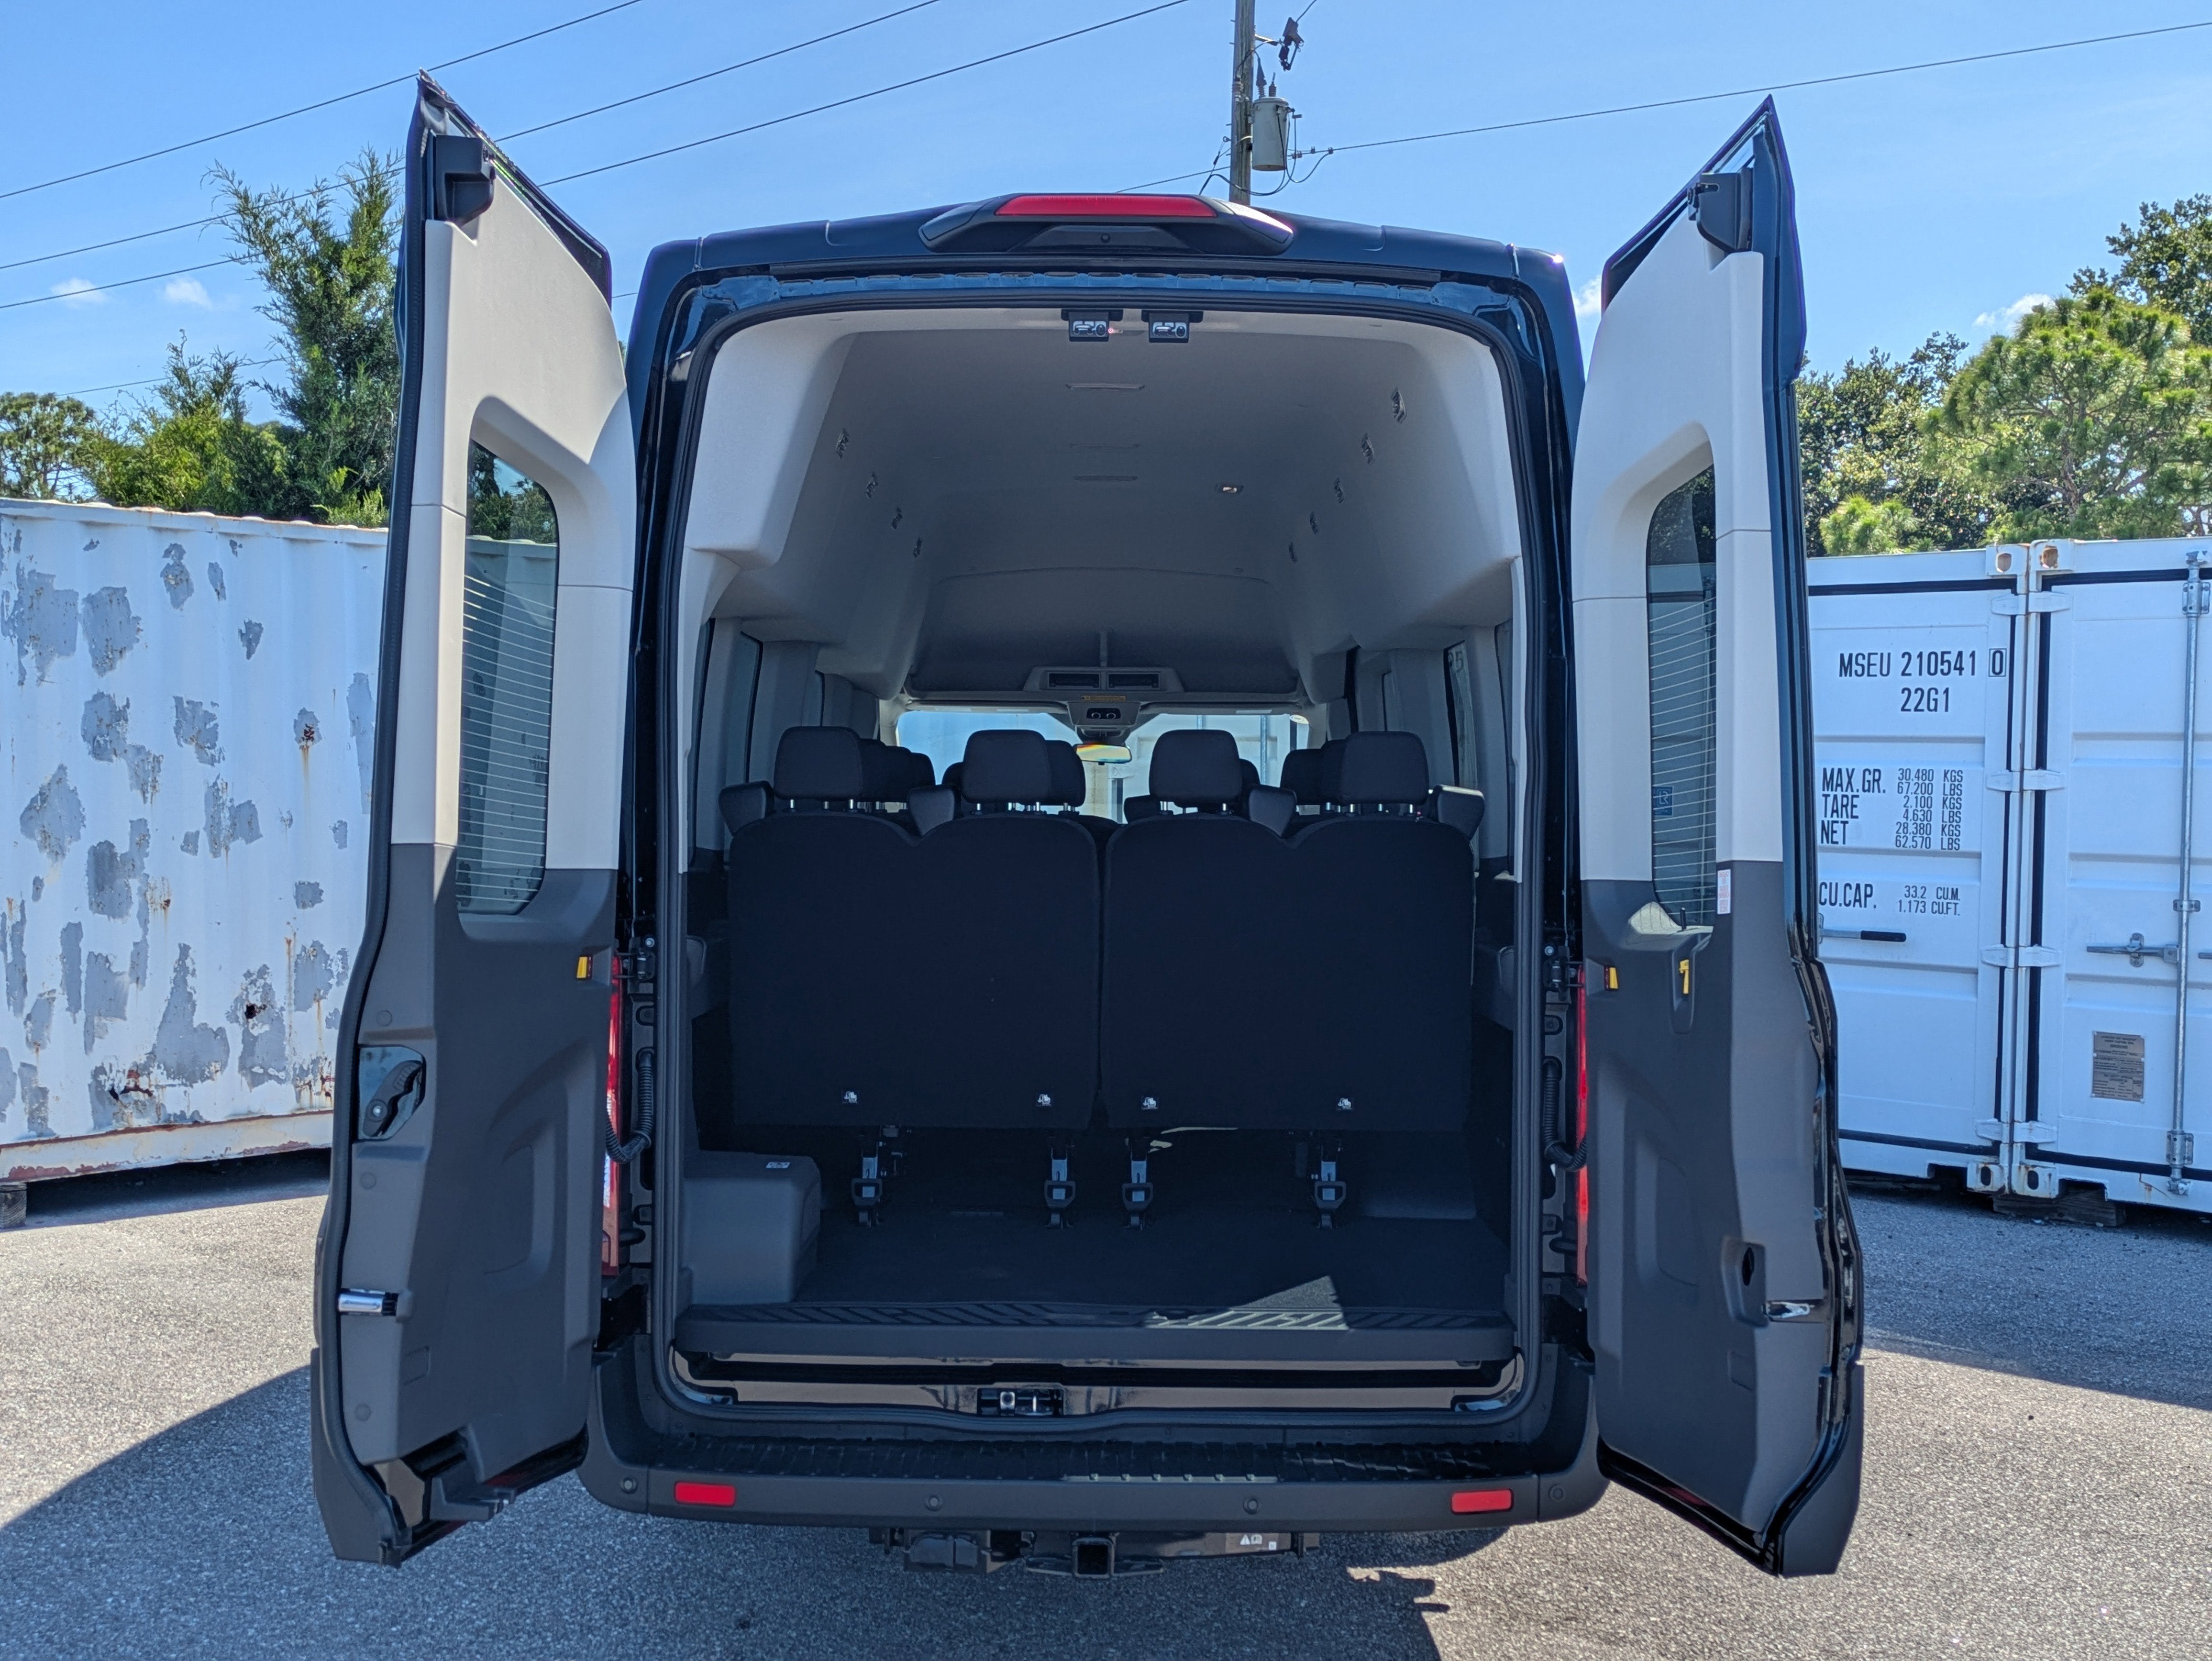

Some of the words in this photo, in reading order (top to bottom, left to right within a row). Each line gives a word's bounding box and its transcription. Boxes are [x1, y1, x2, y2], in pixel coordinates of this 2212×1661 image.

[1839, 653, 1891, 677] MSEU
[1901, 650, 1976, 676] 210541
[1991, 650, 2004, 675] 0
[1900, 687, 1949, 712] 22G1
[1822, 767, 1886, 793] MAX.GR.
[1897, 768, 1934, 782] 30.480
[1943, 769, 1963, 783] KGS
[1897, 782, 1934, 795] 67.200
[1942, 783, 1962, 796] LBS
[1822, 794, 1859, 819] TARE
[1903, 796, 1933, 809] 2.100
[1942, 797, 1962, 810] KGS
[1902, 808, 1933, 822] 4.630
[1941, 810, 1961, 823] LBS
[1820, 820, 1849, 845] NET
[1895, 821, 1932, 836] 28.380
[1941, 824, 1961, 837] KGS
[1895, 835, 1932, 850] 62.570
[1940, 837, 1960, 851] LBS
[1818, 882, 1877, 909] CU.CAP.
[1904, 885, 1927, 899] 33.2
[1898, 899, 1927, 913] 1.173
